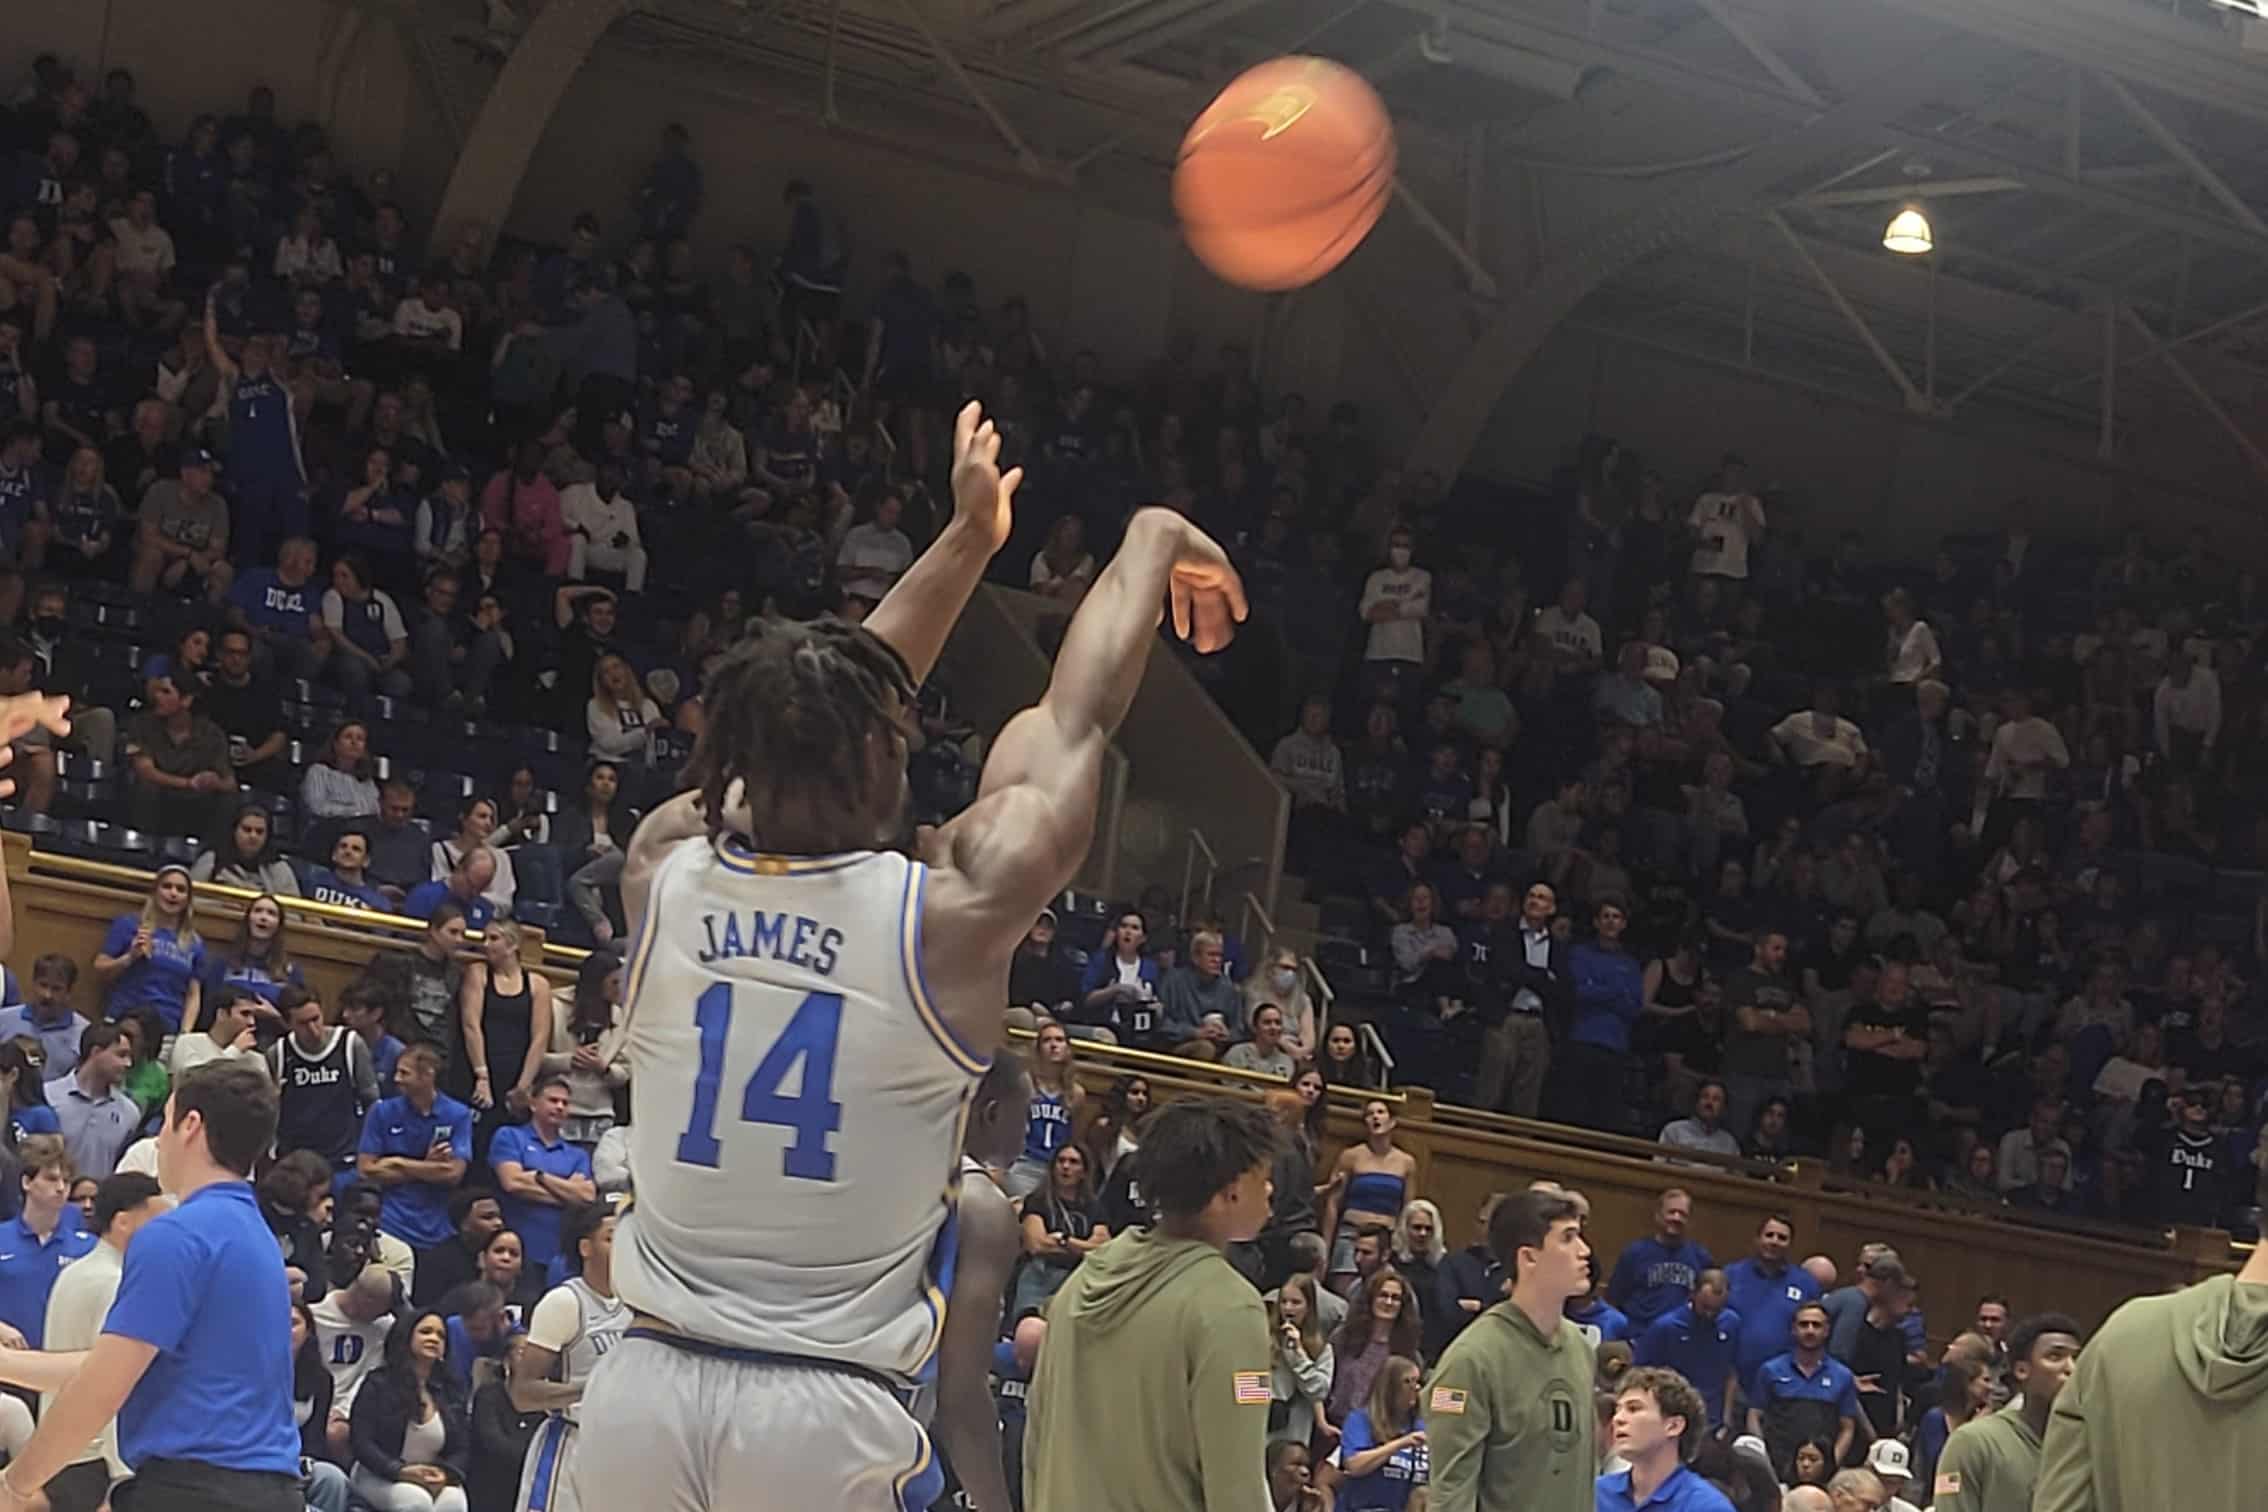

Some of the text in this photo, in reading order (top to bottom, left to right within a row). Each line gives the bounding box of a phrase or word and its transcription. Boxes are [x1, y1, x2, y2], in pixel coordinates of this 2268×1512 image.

[319, 886, 373, 911] DUK
[699, 911, 845, 976] JAMES
[294, 1066, 340, 1086] Duke
[676, 981, 848, 1182] 14
[1044, 1122, 1055, 1148] 1
[2171, 1147, 2213, 1169] Duke
[2184, 1168, 2193, 1189] 1
[1552, 1399, 1572, 1433] D
